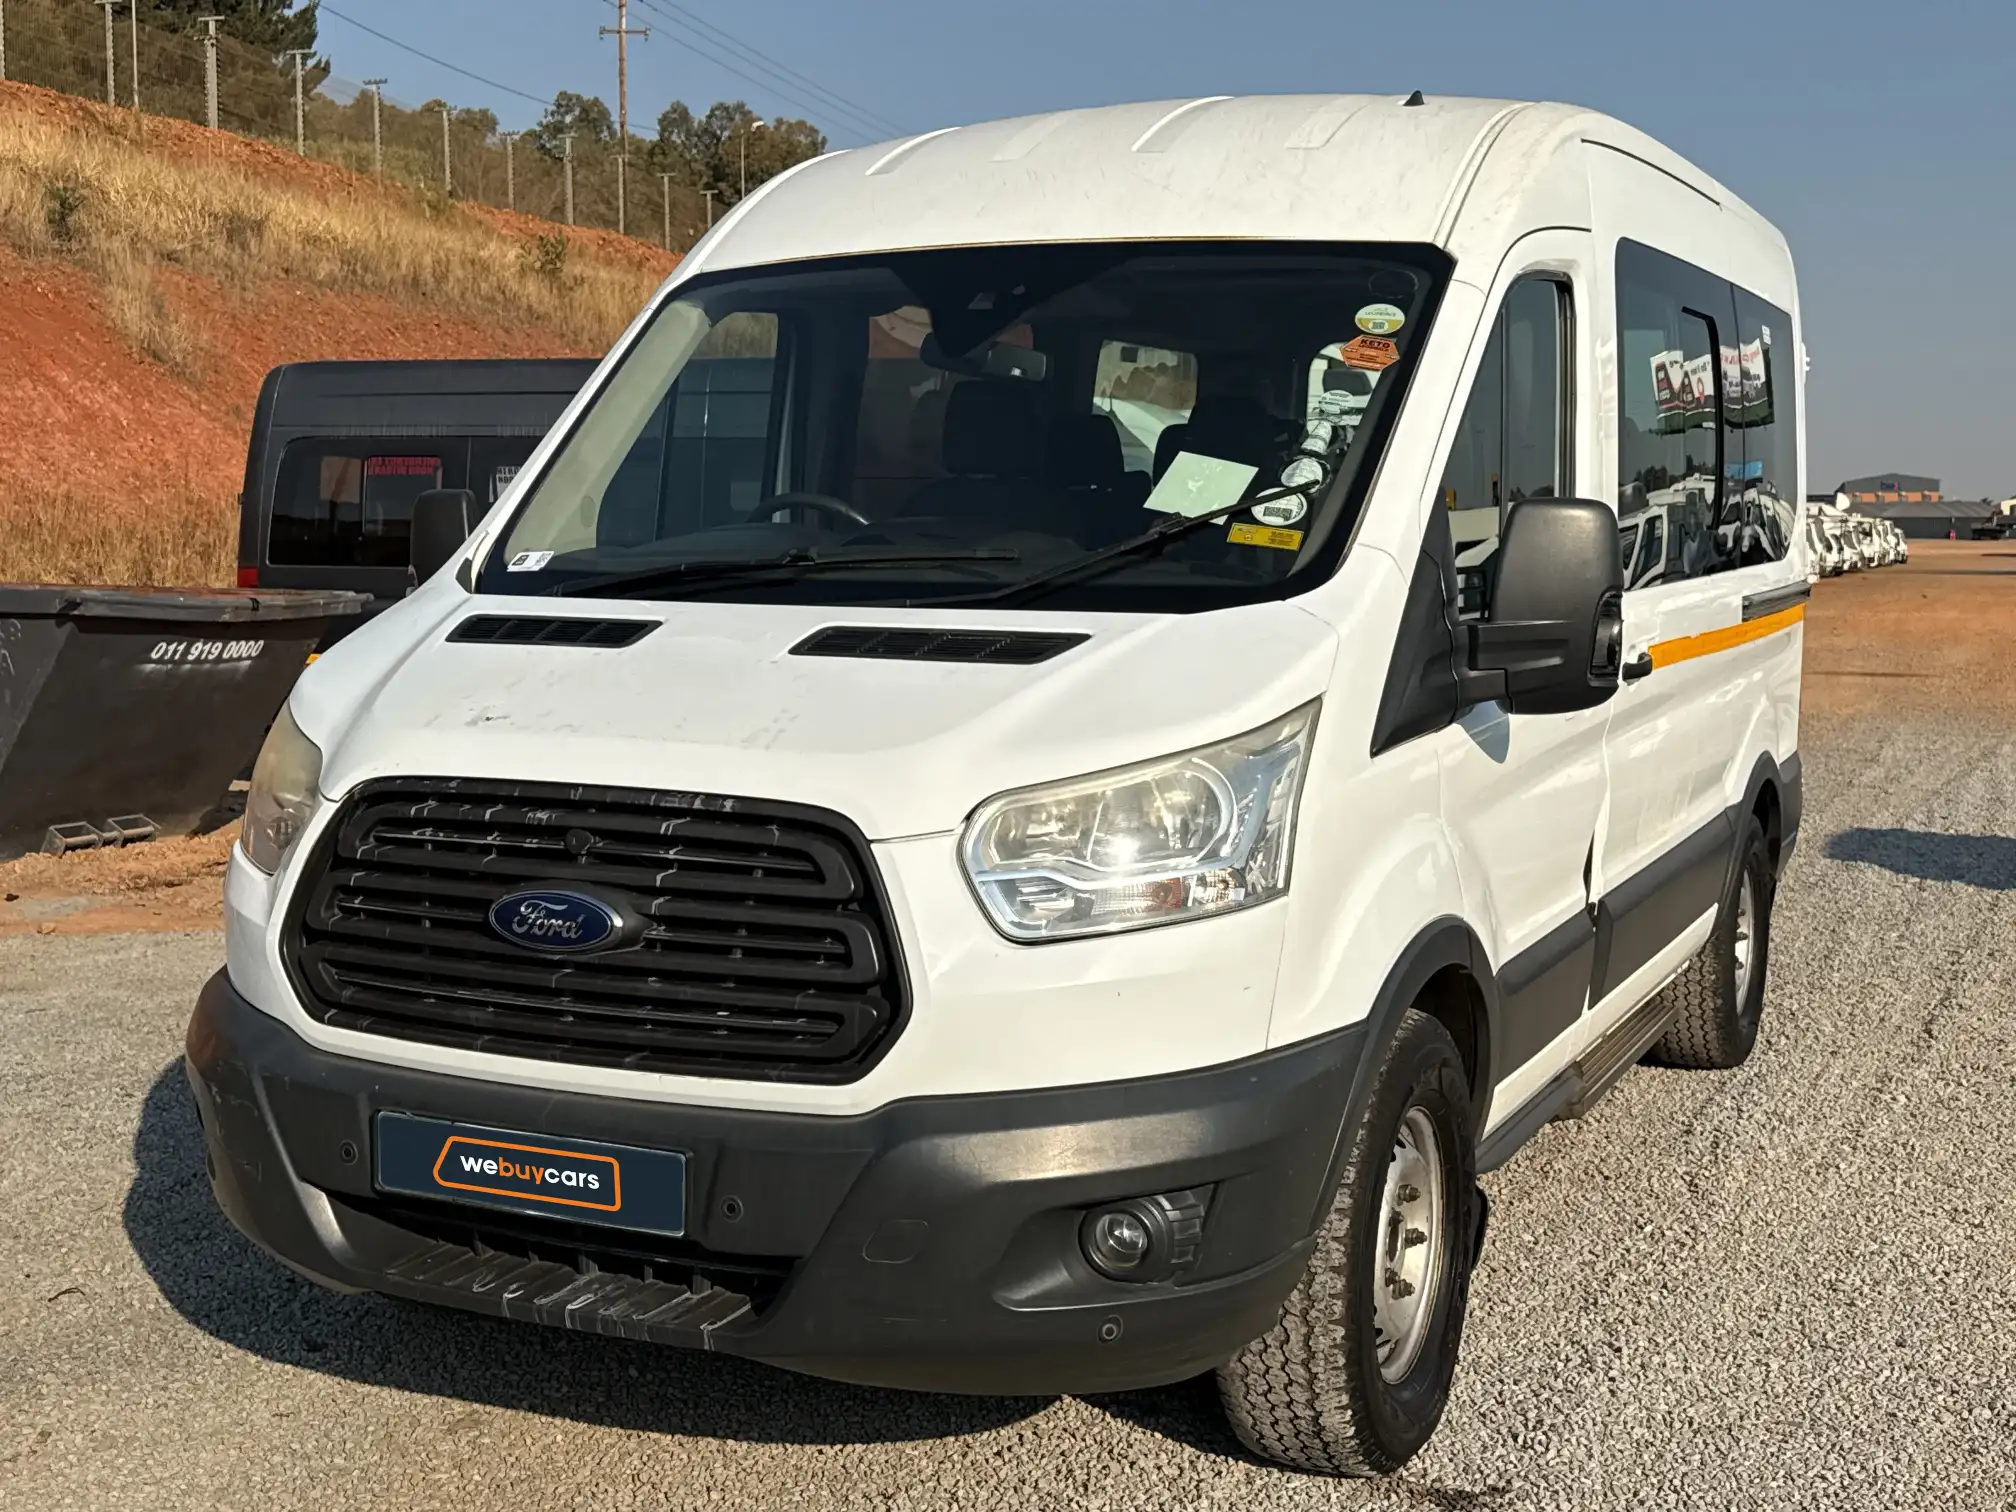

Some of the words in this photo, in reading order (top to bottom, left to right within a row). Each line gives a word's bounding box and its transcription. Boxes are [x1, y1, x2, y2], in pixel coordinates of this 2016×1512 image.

[1360, 339, 1391, 349] KETO
[150, 641, 187, 660] 011
[187, 638, 223, 660] 919
[222, 639, 265, 659] 0000
[511, 899, 586, 940] Ford
